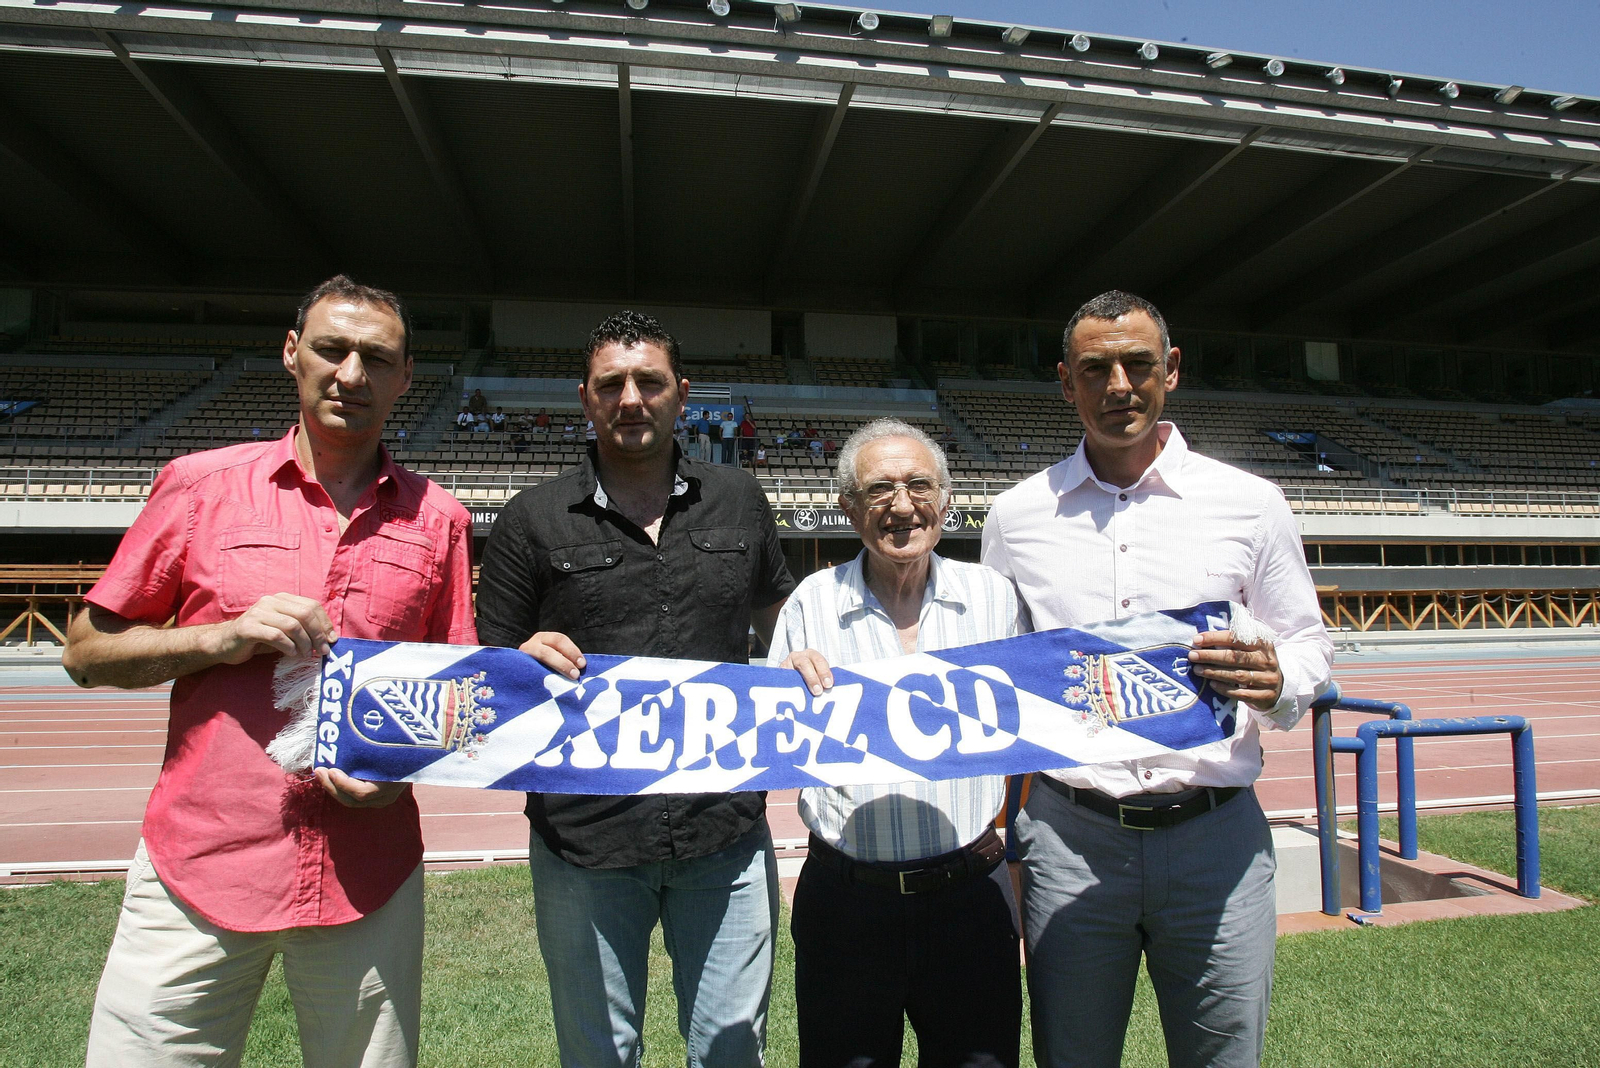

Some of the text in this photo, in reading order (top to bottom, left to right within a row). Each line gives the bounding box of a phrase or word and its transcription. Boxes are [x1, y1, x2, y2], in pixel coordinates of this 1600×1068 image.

[821, 515, 852, 526] ALIME
[964, 513, 988, 529] And
[317, 649, 354, 765] Xerez
[533, 664, 1021, 770] XEREZ CD
